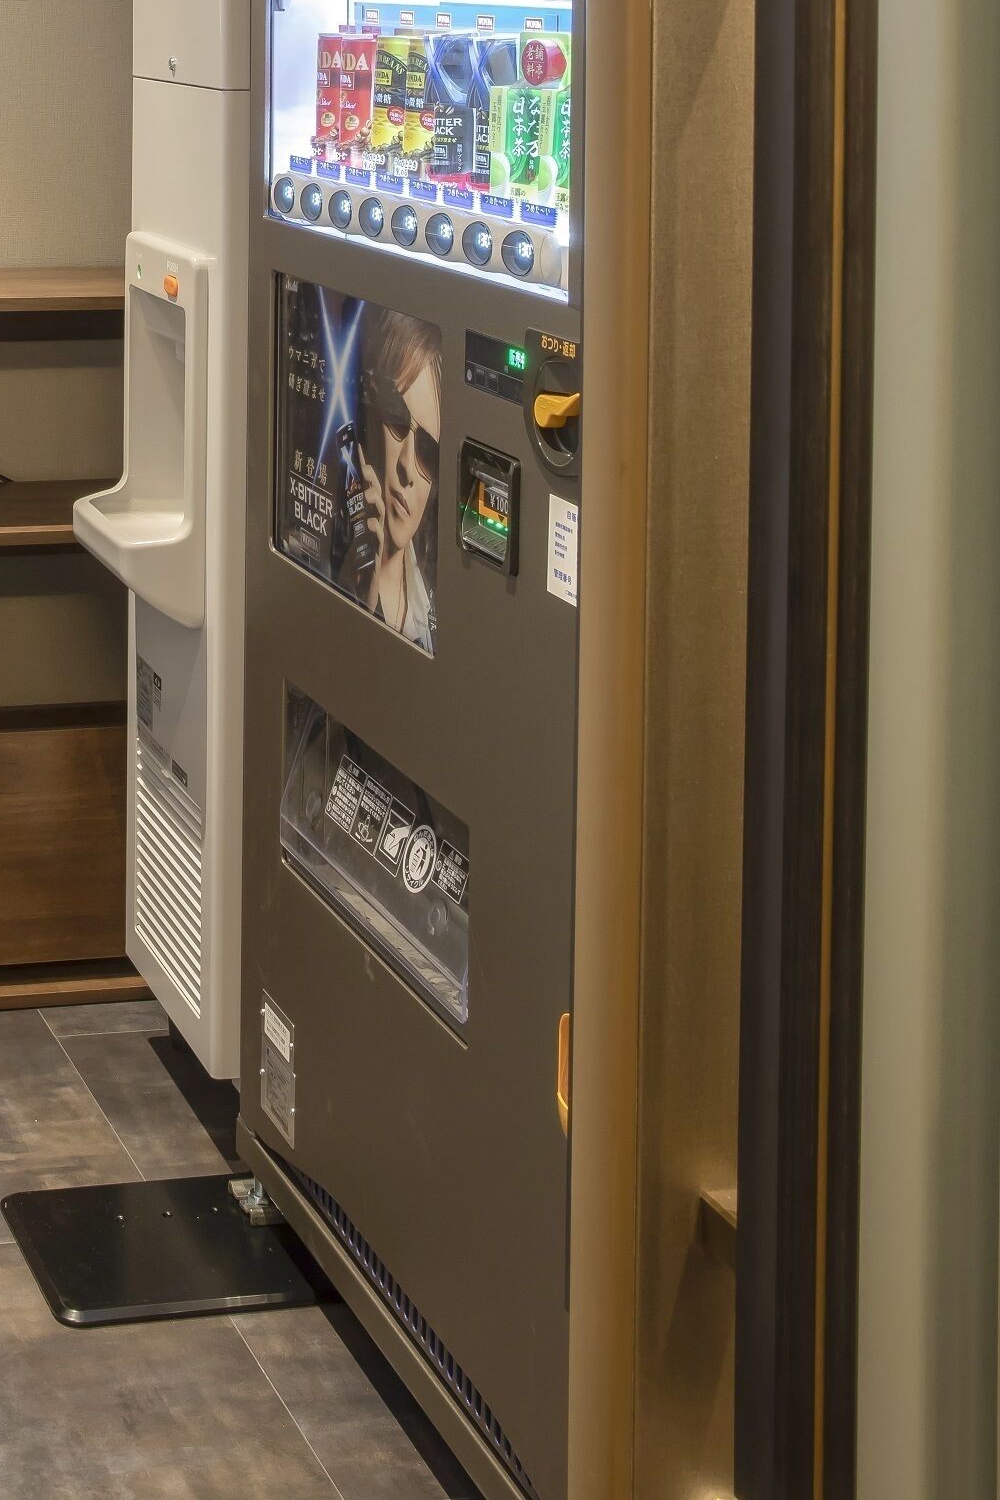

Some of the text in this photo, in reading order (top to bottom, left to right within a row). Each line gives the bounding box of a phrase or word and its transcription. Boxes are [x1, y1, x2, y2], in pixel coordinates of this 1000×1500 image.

[511, 96, 527, 158] 日本茶
[293, 449, 328, 487] 新登場
[290, 476, 333, 518] X-BITTER
[294, 500, 328, 536] BLACK
